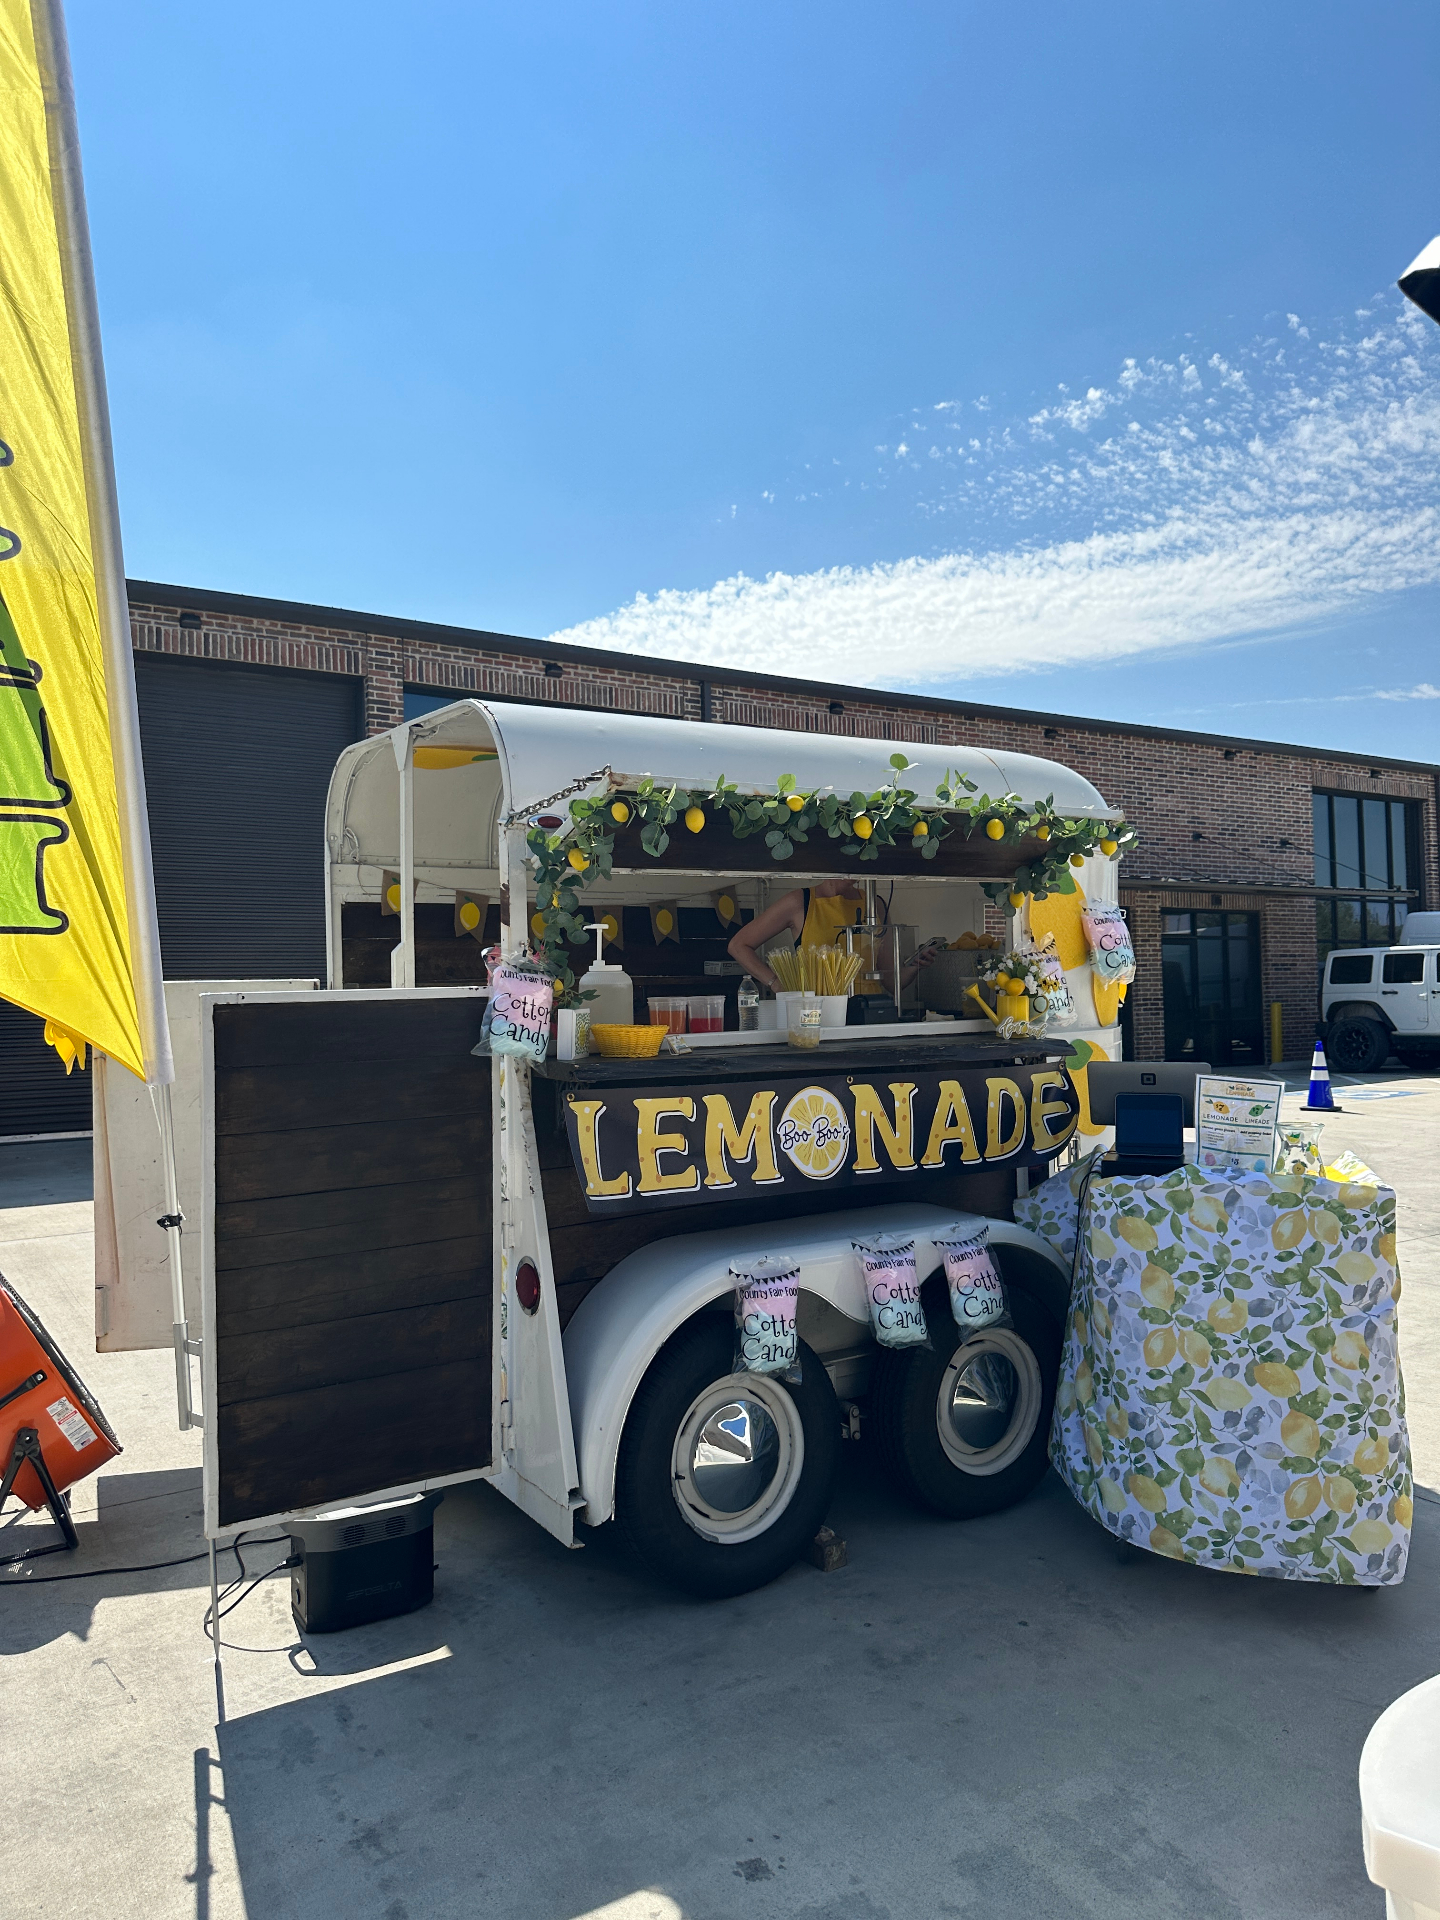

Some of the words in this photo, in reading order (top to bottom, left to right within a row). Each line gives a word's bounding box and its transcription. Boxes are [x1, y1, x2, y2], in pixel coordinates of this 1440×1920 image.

[540, 978, 554, 988] Foo
[489, 1013, 550, 1056] Candy
[1203, 1114, 1239, 1122] LEMONADE
[778, 1119, 812, 1150] Boo
[811, 1116, 851, 1148] Boo's
[866, 1259, 893, 1272] County
[892, 1257, 905, 1268] Fair
[904, 1257, 917, 1268] Foo
[949, 1251, 973, 1265] County
[740, 1289, 768, 1300] County
[768, 1287, 784, 1298] Fair
[784, 1286, 798, 1297] Foo
[872, 1283, 921, 1306] Cotto
[956, 1270, 1001, 1296] Cotto
[963, 1295, 1004, 1318] Cand
[743, 1313, 797, 1338] Cotto
[742, 1333, 796, 1363] Cand
